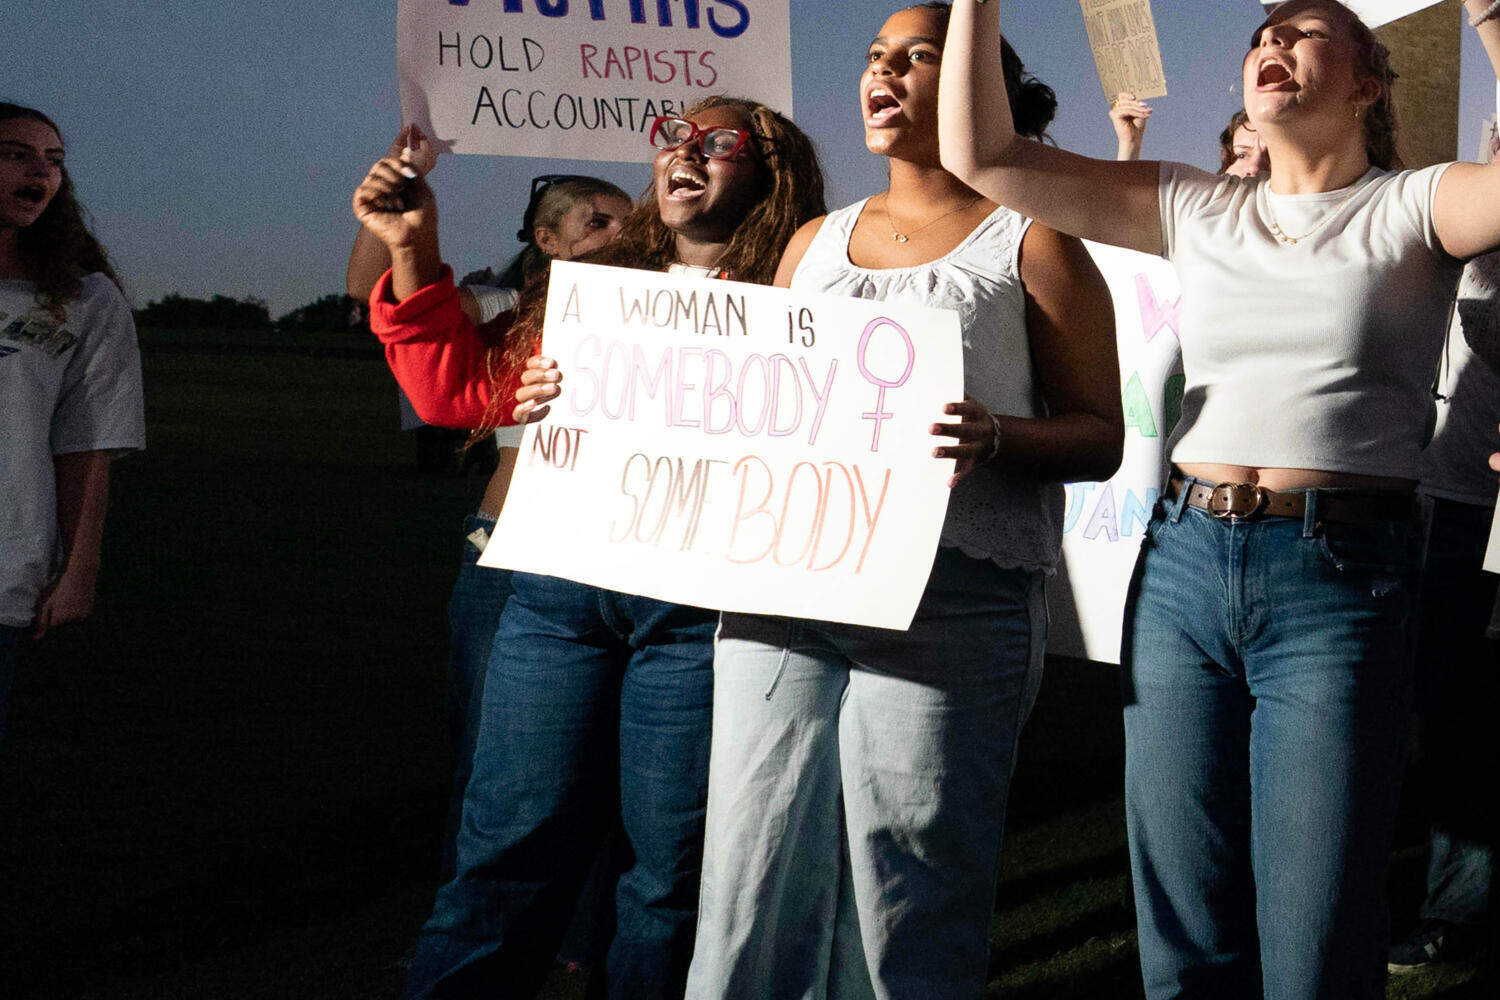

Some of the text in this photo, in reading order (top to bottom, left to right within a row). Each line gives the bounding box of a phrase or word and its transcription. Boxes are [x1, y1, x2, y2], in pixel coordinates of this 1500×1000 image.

[438, 31, 718, 88] HOLD RAPISTS
[562, 282, 582, 324] A
[619, 286, 747, 337] WOMAN
[569, 333, 839, 446] SOMEBODY
[528, 424, 589, 472] NOT
